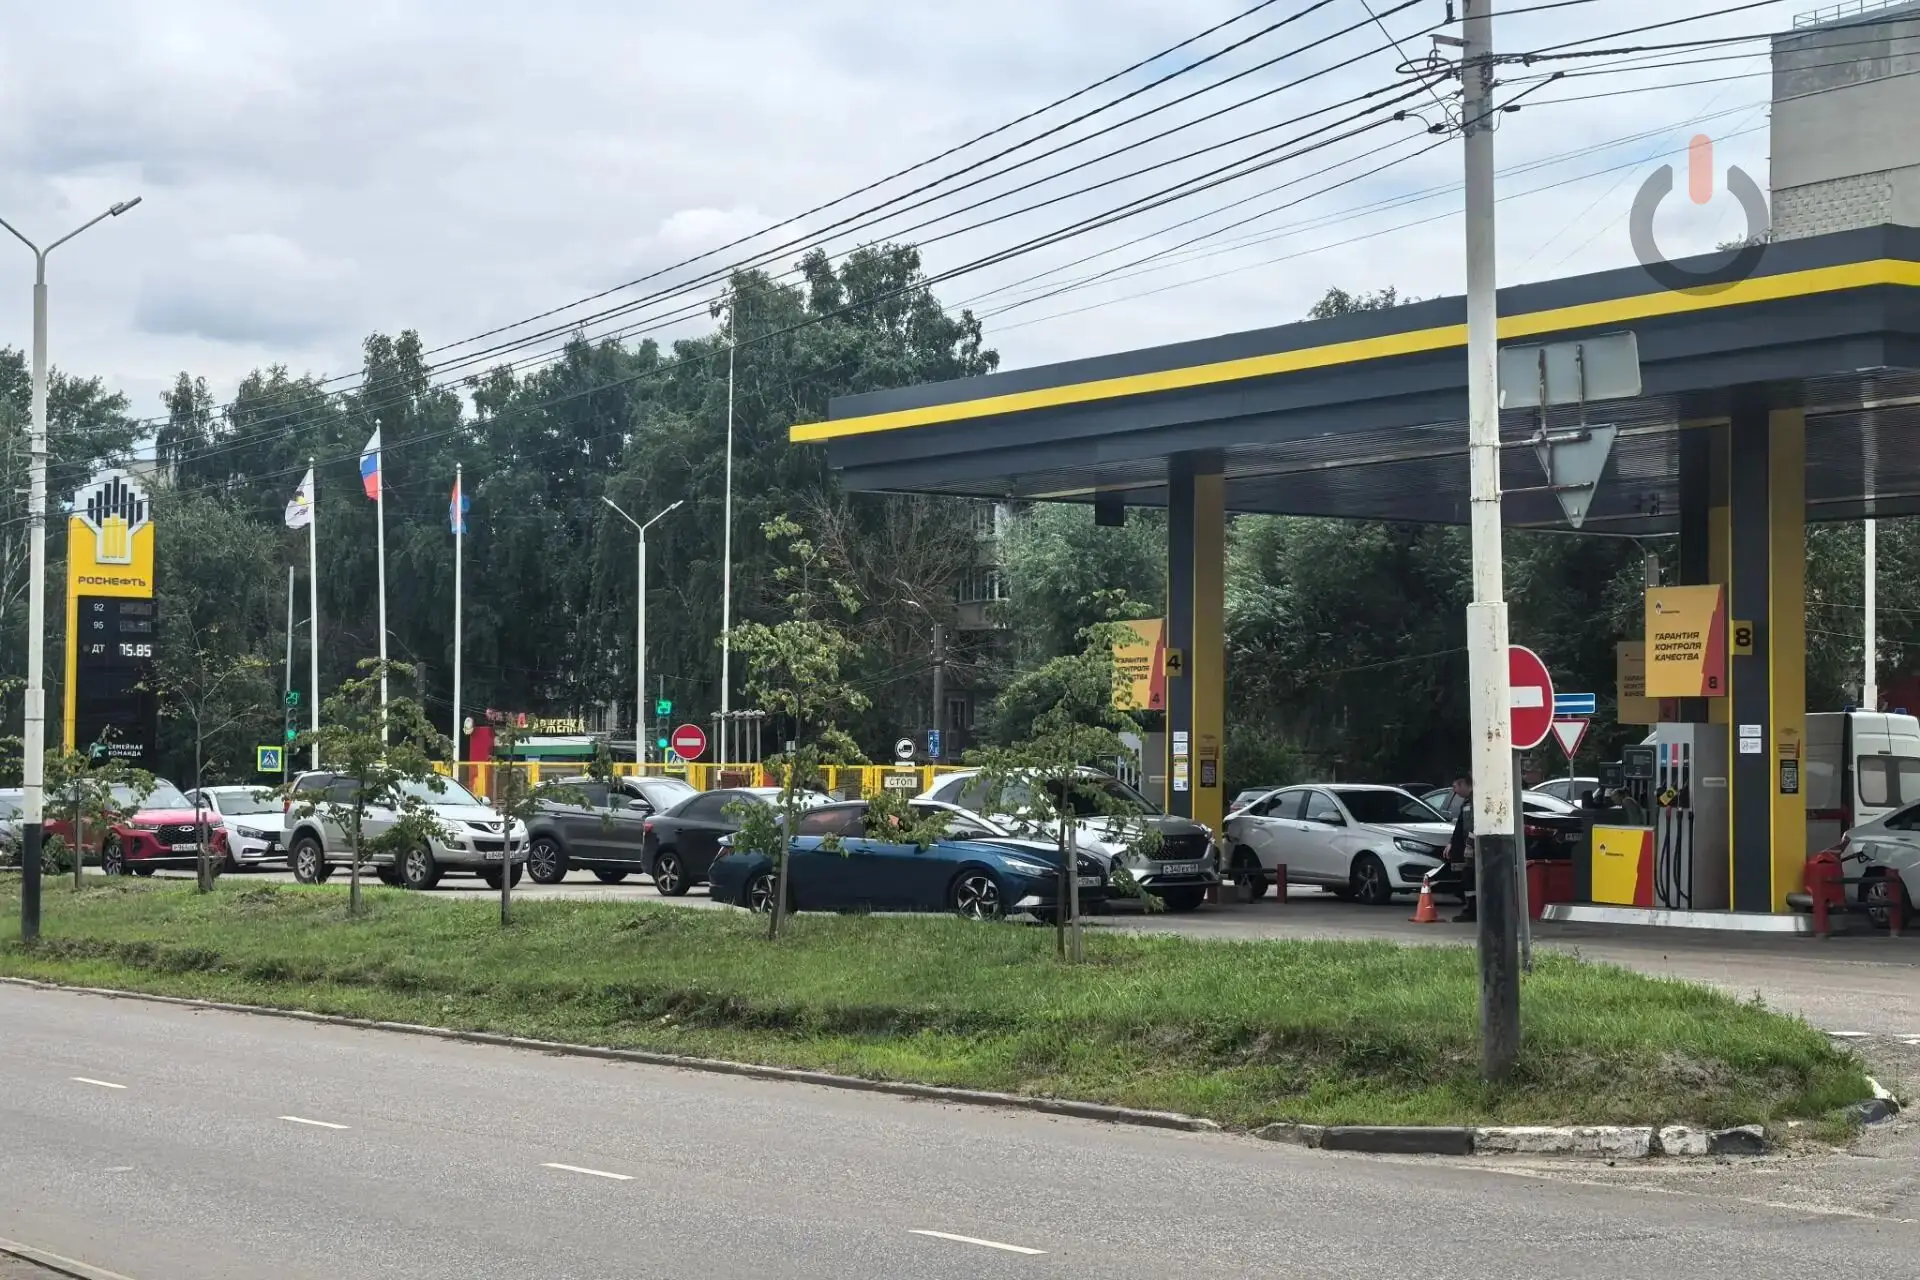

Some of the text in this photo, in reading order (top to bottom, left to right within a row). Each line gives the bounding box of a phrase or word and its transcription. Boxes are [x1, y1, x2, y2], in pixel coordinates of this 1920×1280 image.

[78, 576, 146, 587] РОСНЕФТЬ
[93, 603, 104, 612] 92
[93, 621, 104, 630] 95
[1654, 631, 1700, 641] ГАРАНТИЯ
[1736, 627, 1751, 647] 8
[92, 643, 152, 657] ДТ 75.85
[1654, 642, 1702, 651] КОНТРОЛЯ
[1654, 652, 1700, 662] КАЧЕСТВА
[1166, 655, 1182, 670] 4
[1708, 676, 1718, 689] 8
[1152, 692, 1161, 704] 4
[889, 778, 913, 786] СТОП
